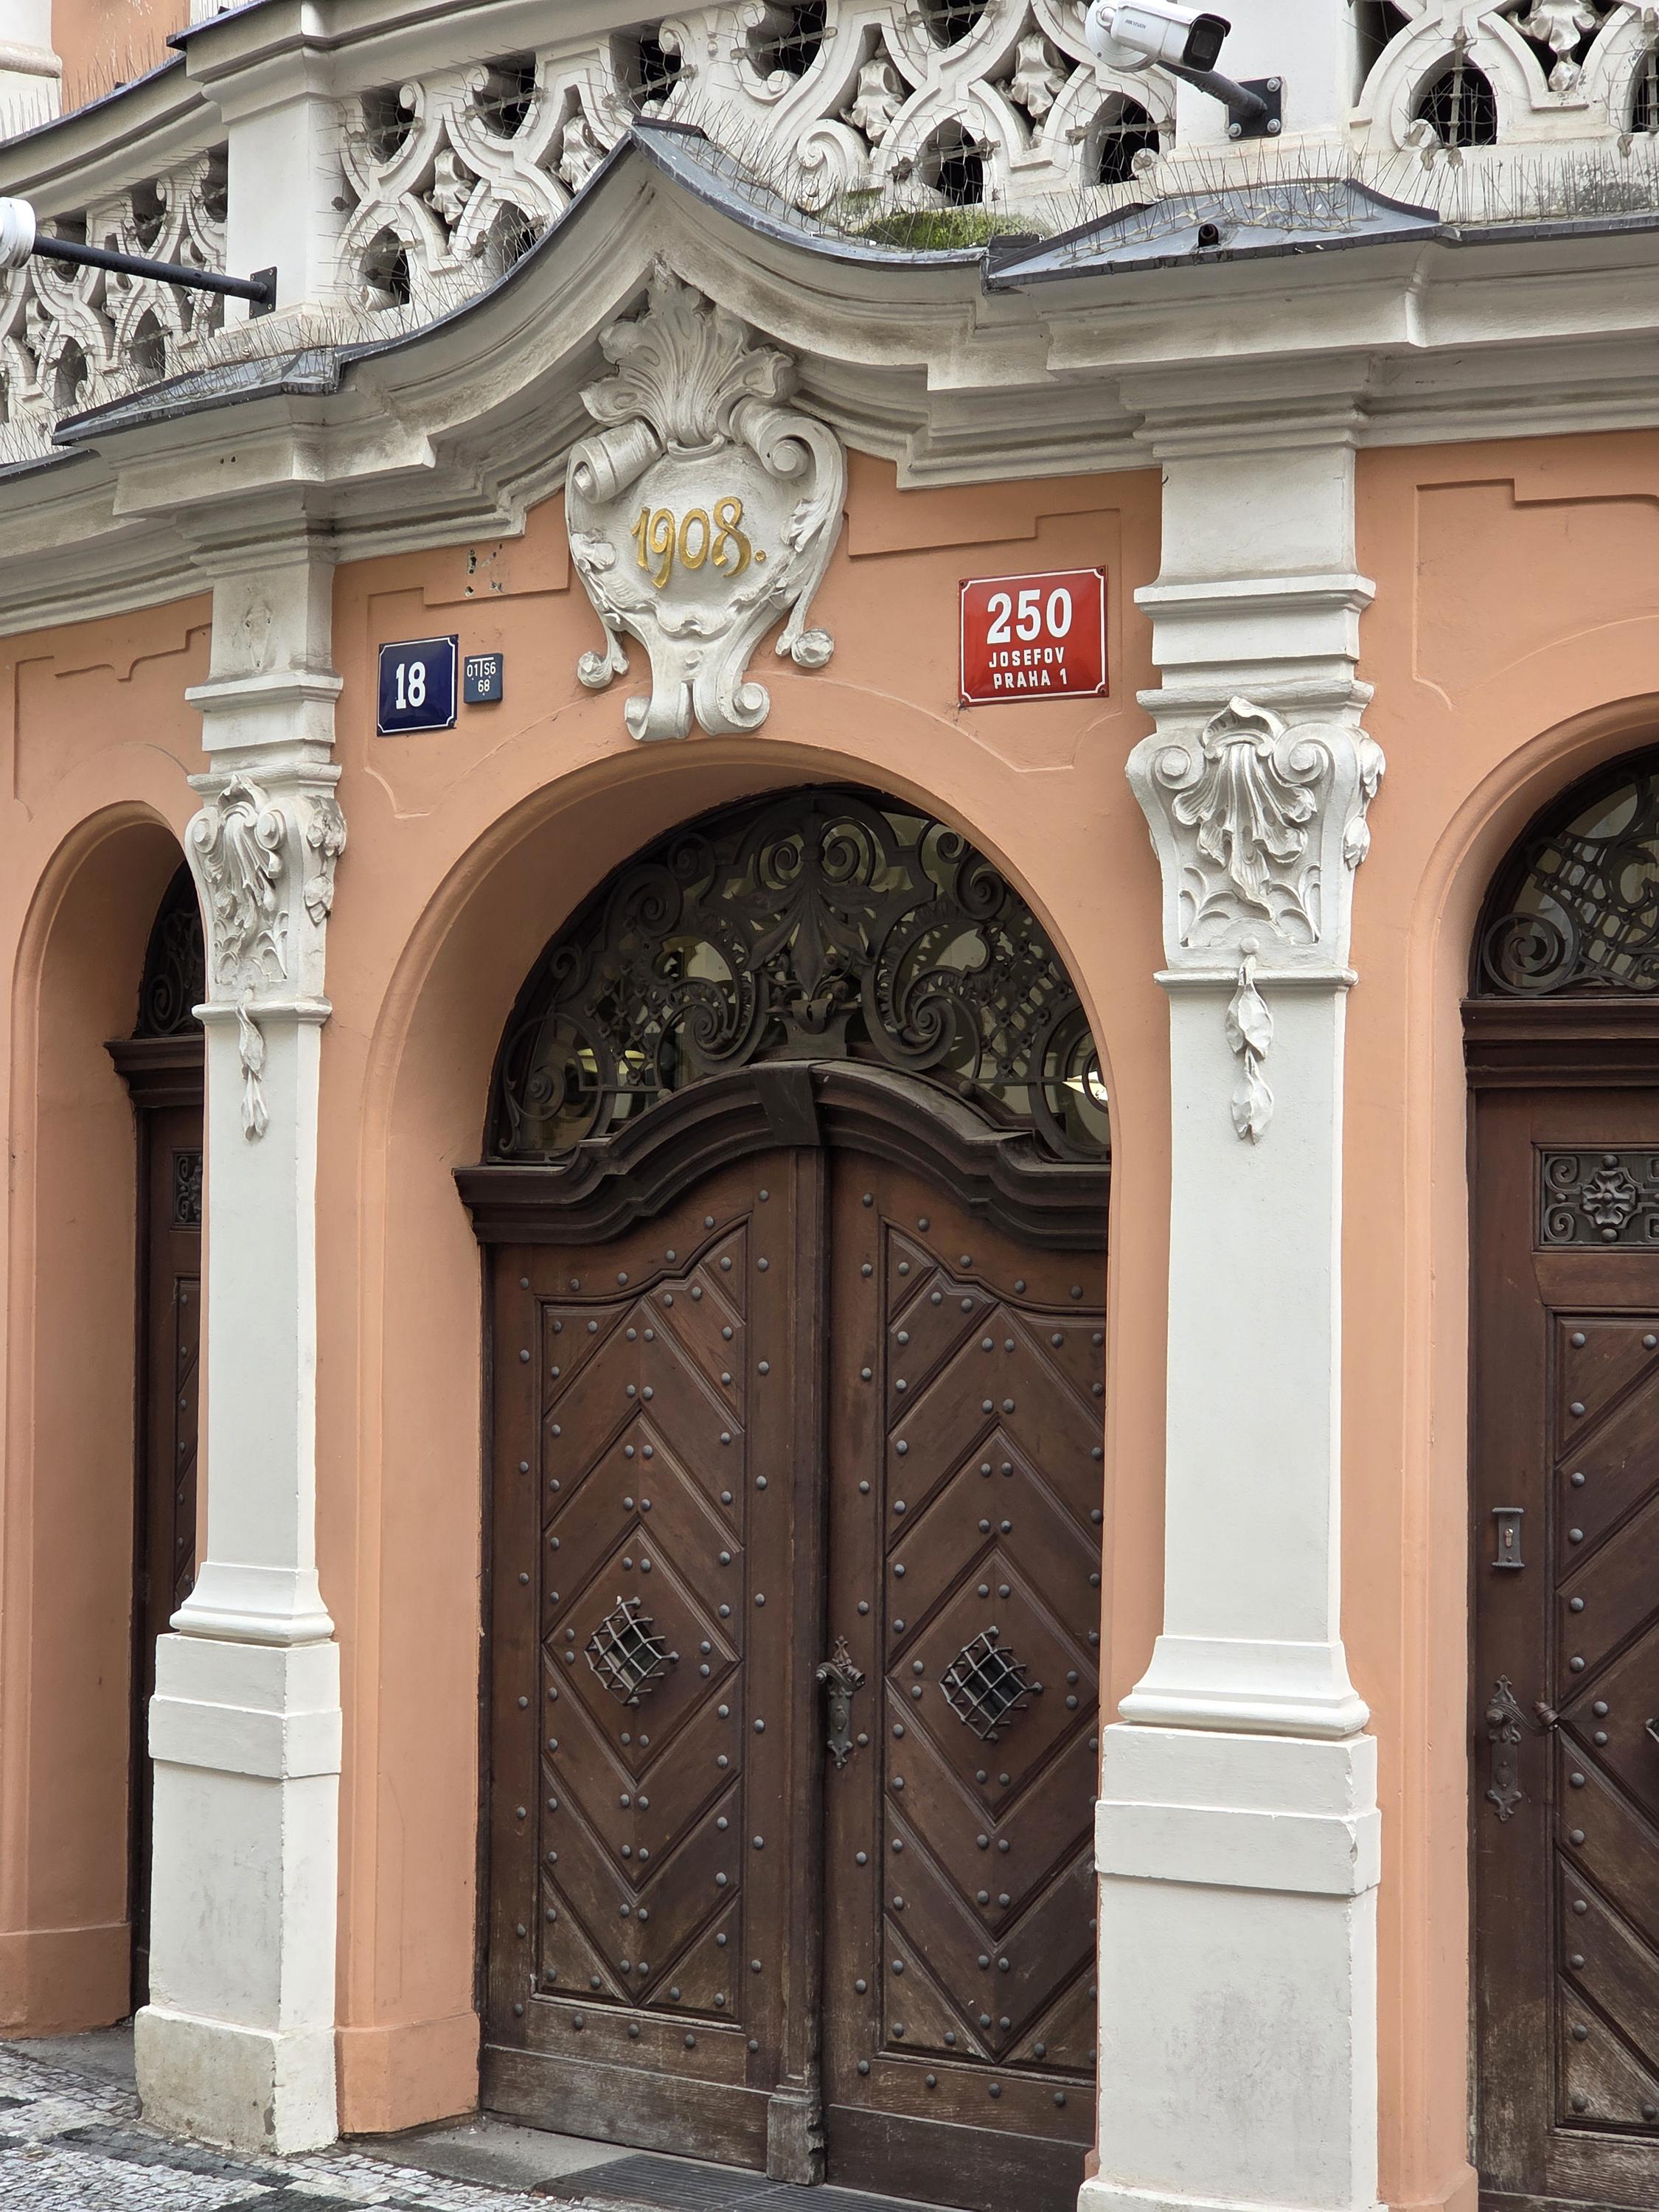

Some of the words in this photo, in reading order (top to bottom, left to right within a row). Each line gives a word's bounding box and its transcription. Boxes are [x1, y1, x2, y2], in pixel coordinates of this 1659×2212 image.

[987, 588, 1072, 644] 250
[988, 647, 1065, 668] JOSEFOV
[395, 661, 425, 709] 18
[478, 678, 490, 692] 68
[992, 669, 1051, 689] PRAHA
[1060, 668, 1068, 685] 1
